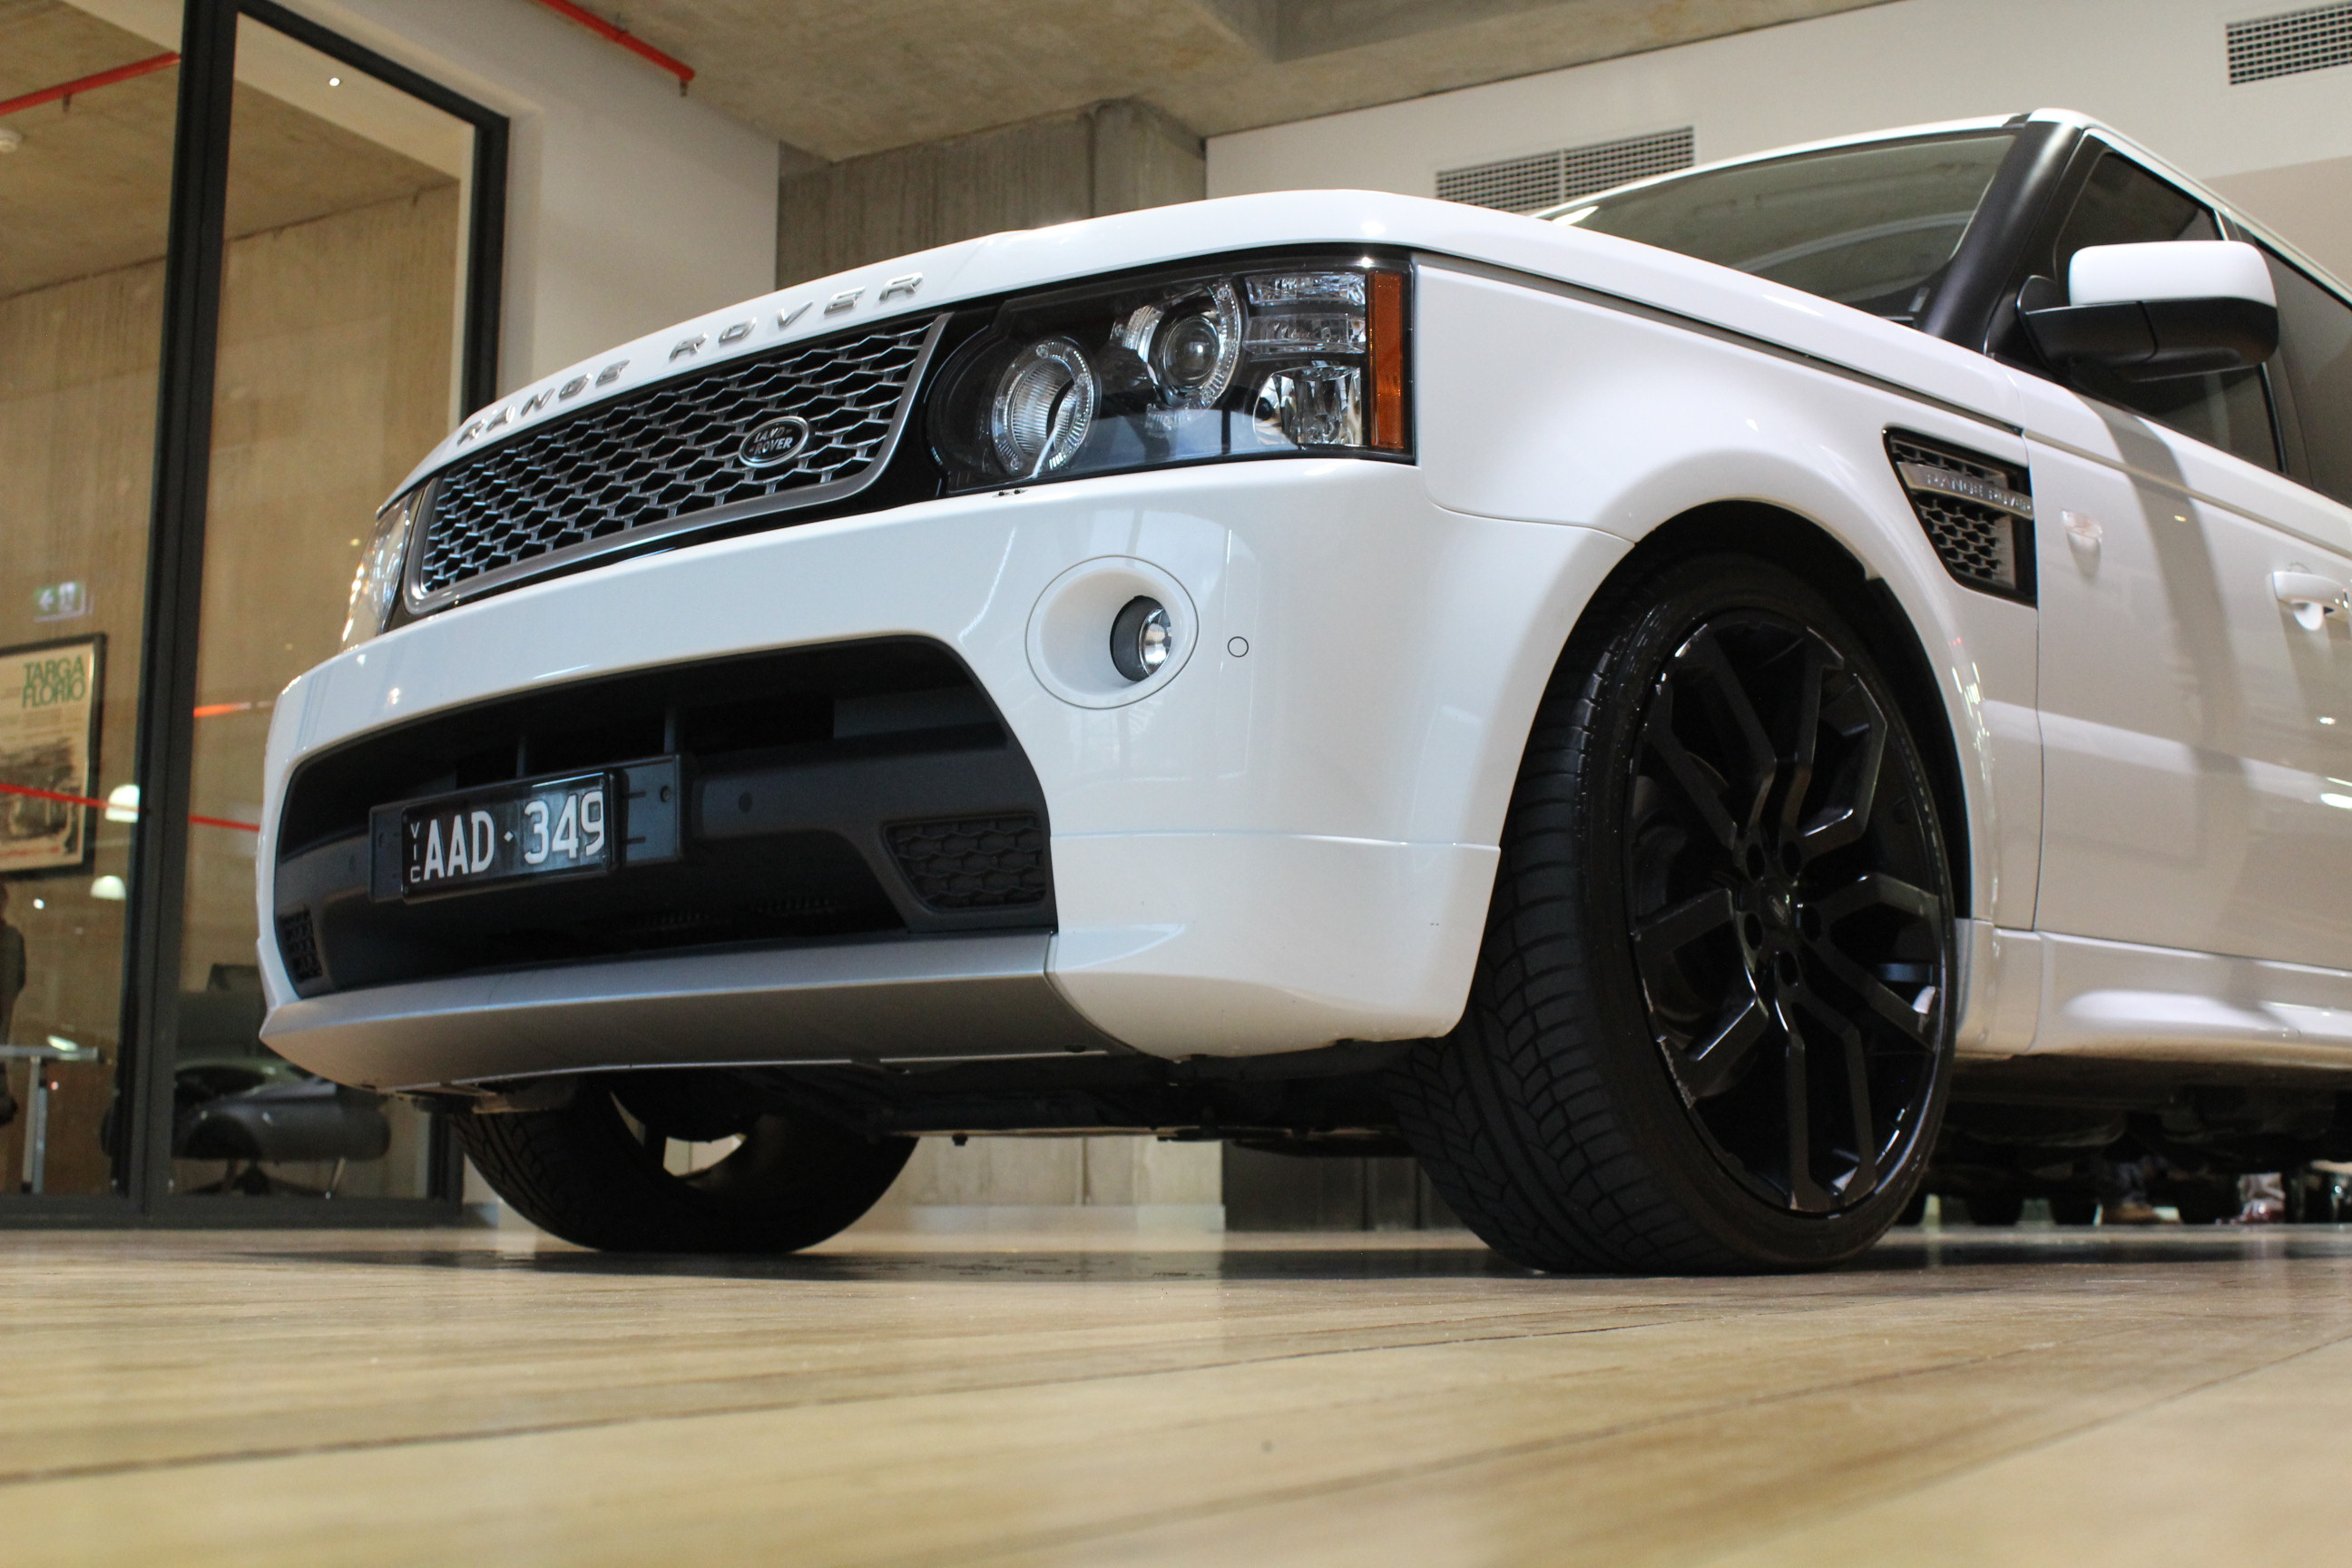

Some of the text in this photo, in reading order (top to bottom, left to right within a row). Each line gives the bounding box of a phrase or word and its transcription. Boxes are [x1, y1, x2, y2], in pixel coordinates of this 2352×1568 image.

[456, 271, 924, 447] RANGE ROVER
[22, 677, 86, 709] FLORIO
[24, 655, 84, 685] TARGA
[410, 821, 421, 883] VIC
[524, 791, 605, 865] 349
